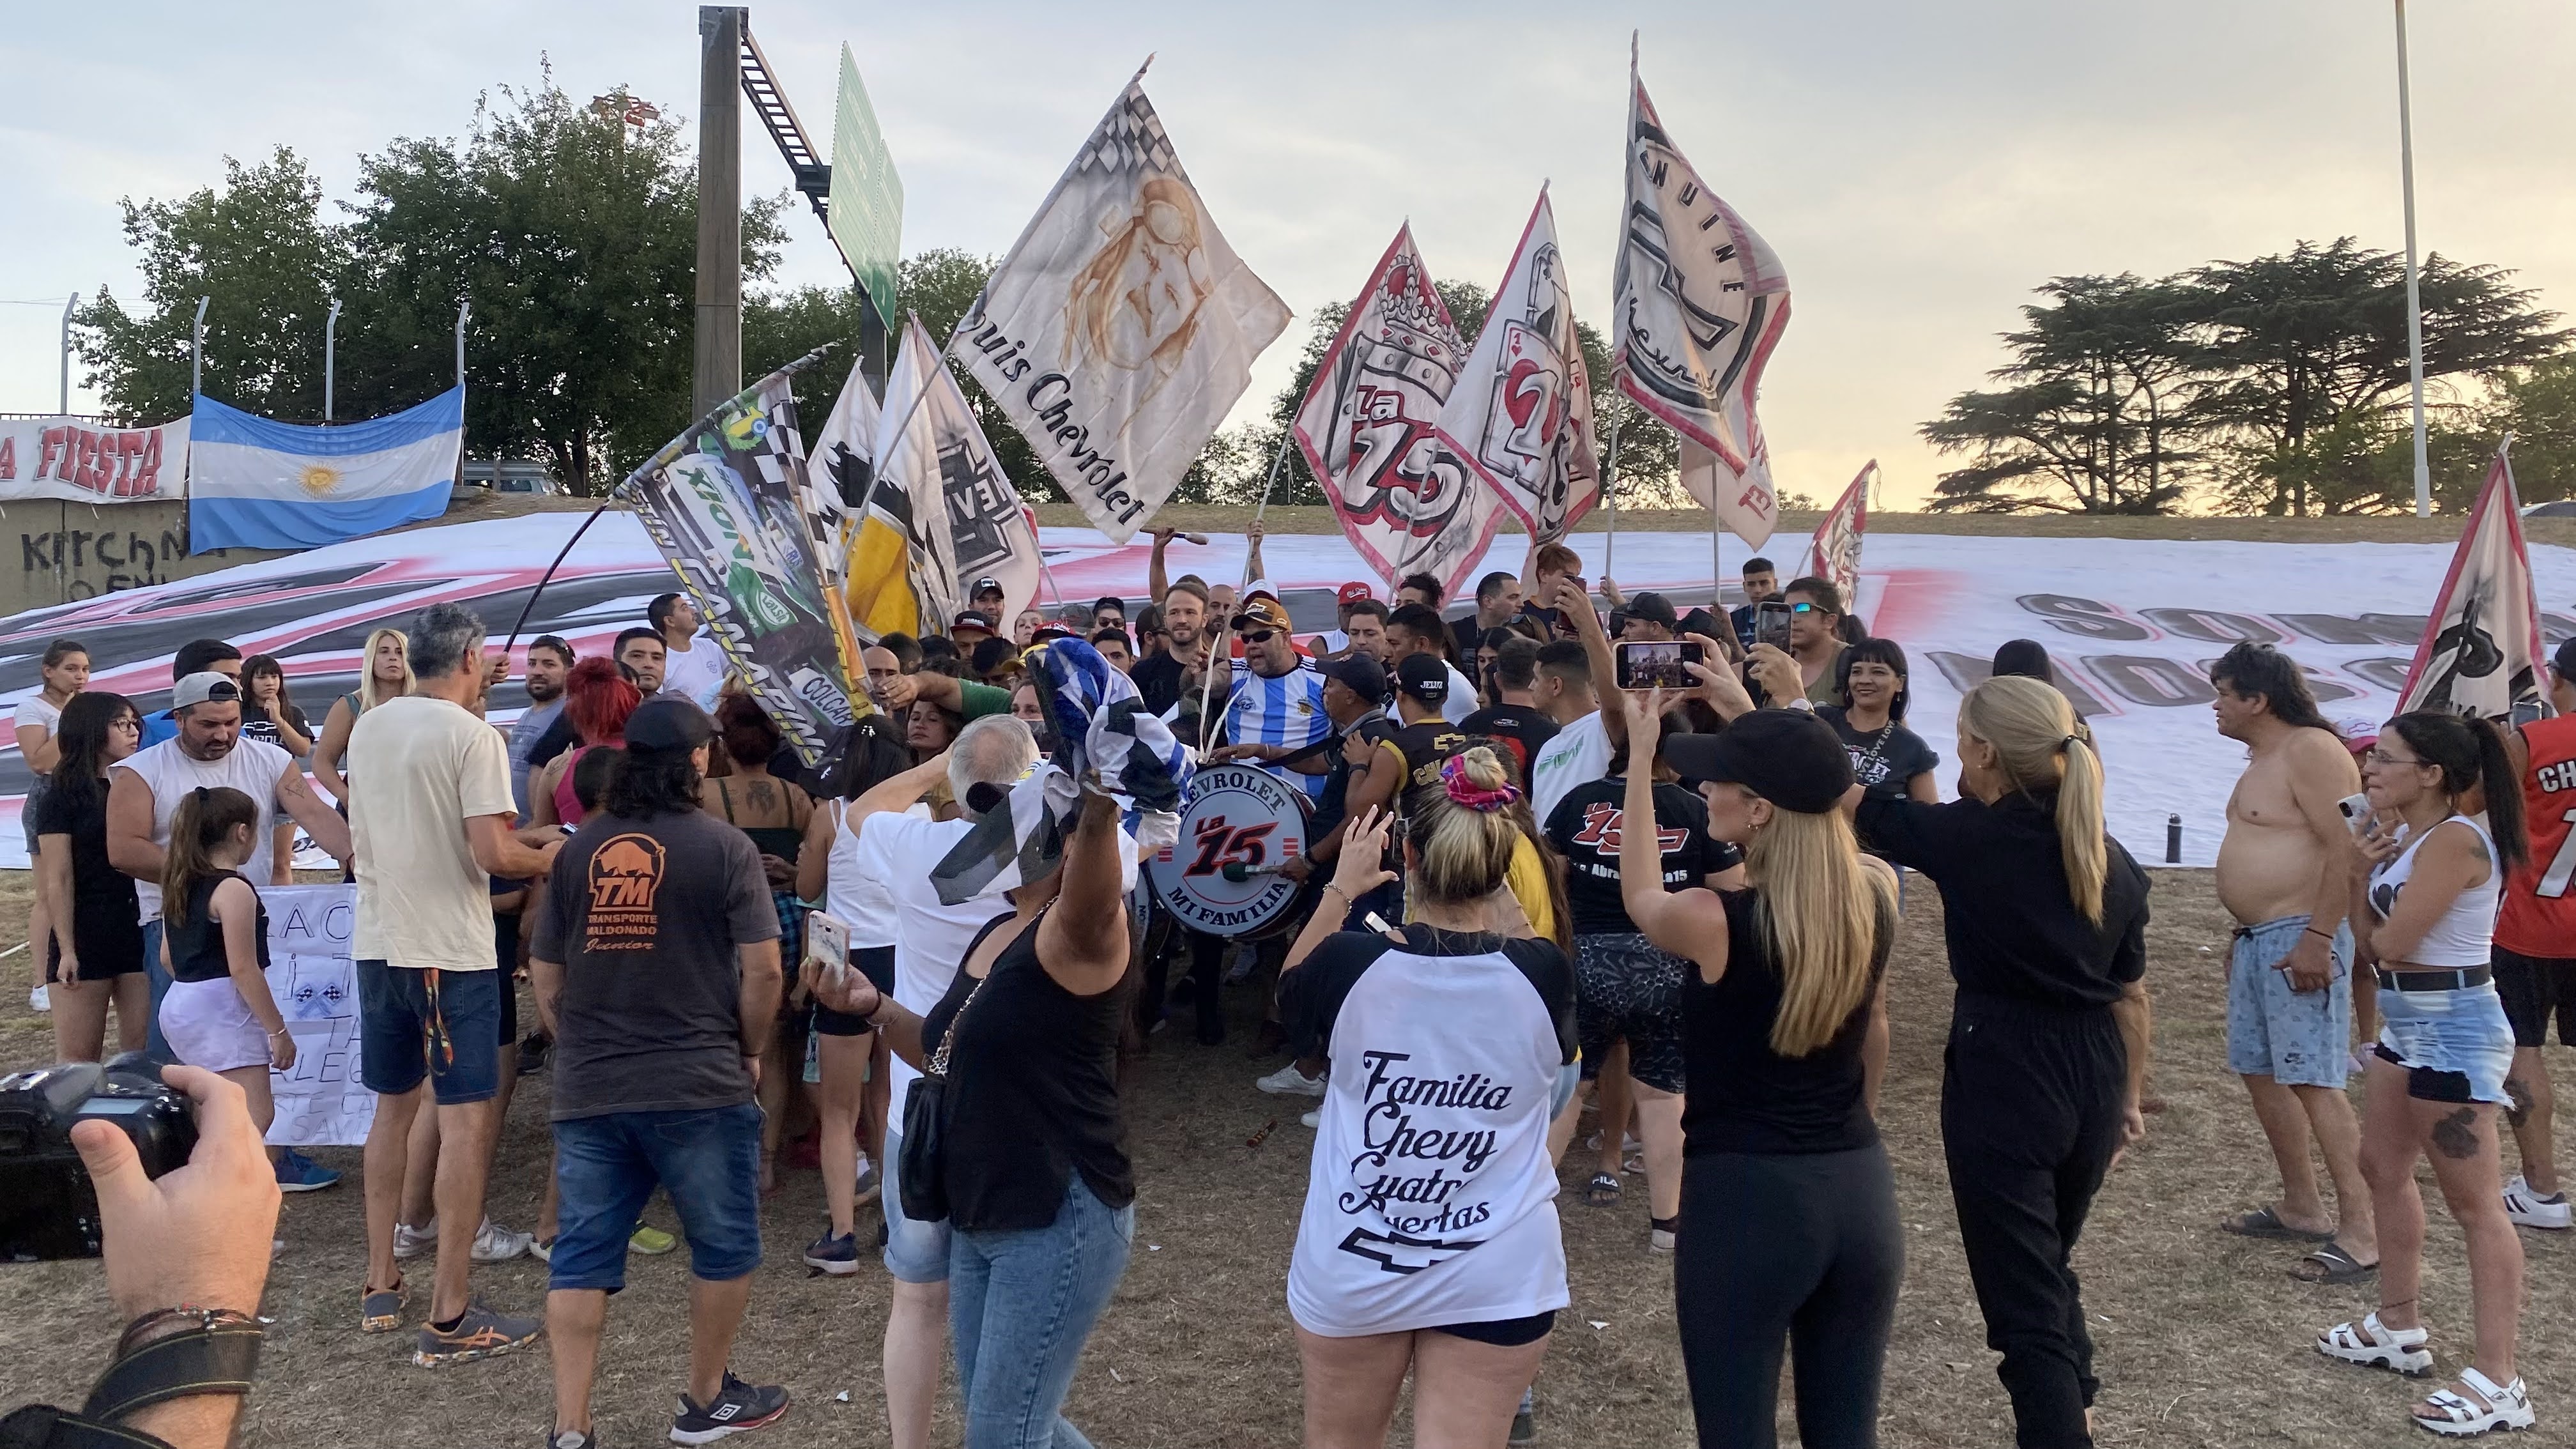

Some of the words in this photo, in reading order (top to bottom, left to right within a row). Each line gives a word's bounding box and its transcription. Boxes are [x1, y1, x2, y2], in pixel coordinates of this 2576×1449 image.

[35, 425, 164, 498] FIESTA
[1027, 373, 1145, 526] Chevrolet
[1881, 719, 1896, 739] LOV
[1867, 739, 1885, 761] LOVE
[1183, 822, 1280, 877] 15
[597, 877, 651, 905] TM
[1167, 886, 1197, 916] MI
[1196, 883, 1289, 926] FAMILIA
[586, 925, 657, 935] MALDONADO
[587, 914, 658, 924] TRANSPORTE
[1363, 1050, 1513, 1111] Familia
[1363, 1101, 1498, 1173] Chevy
[1591, 1177, 1619, 1188] FILA
